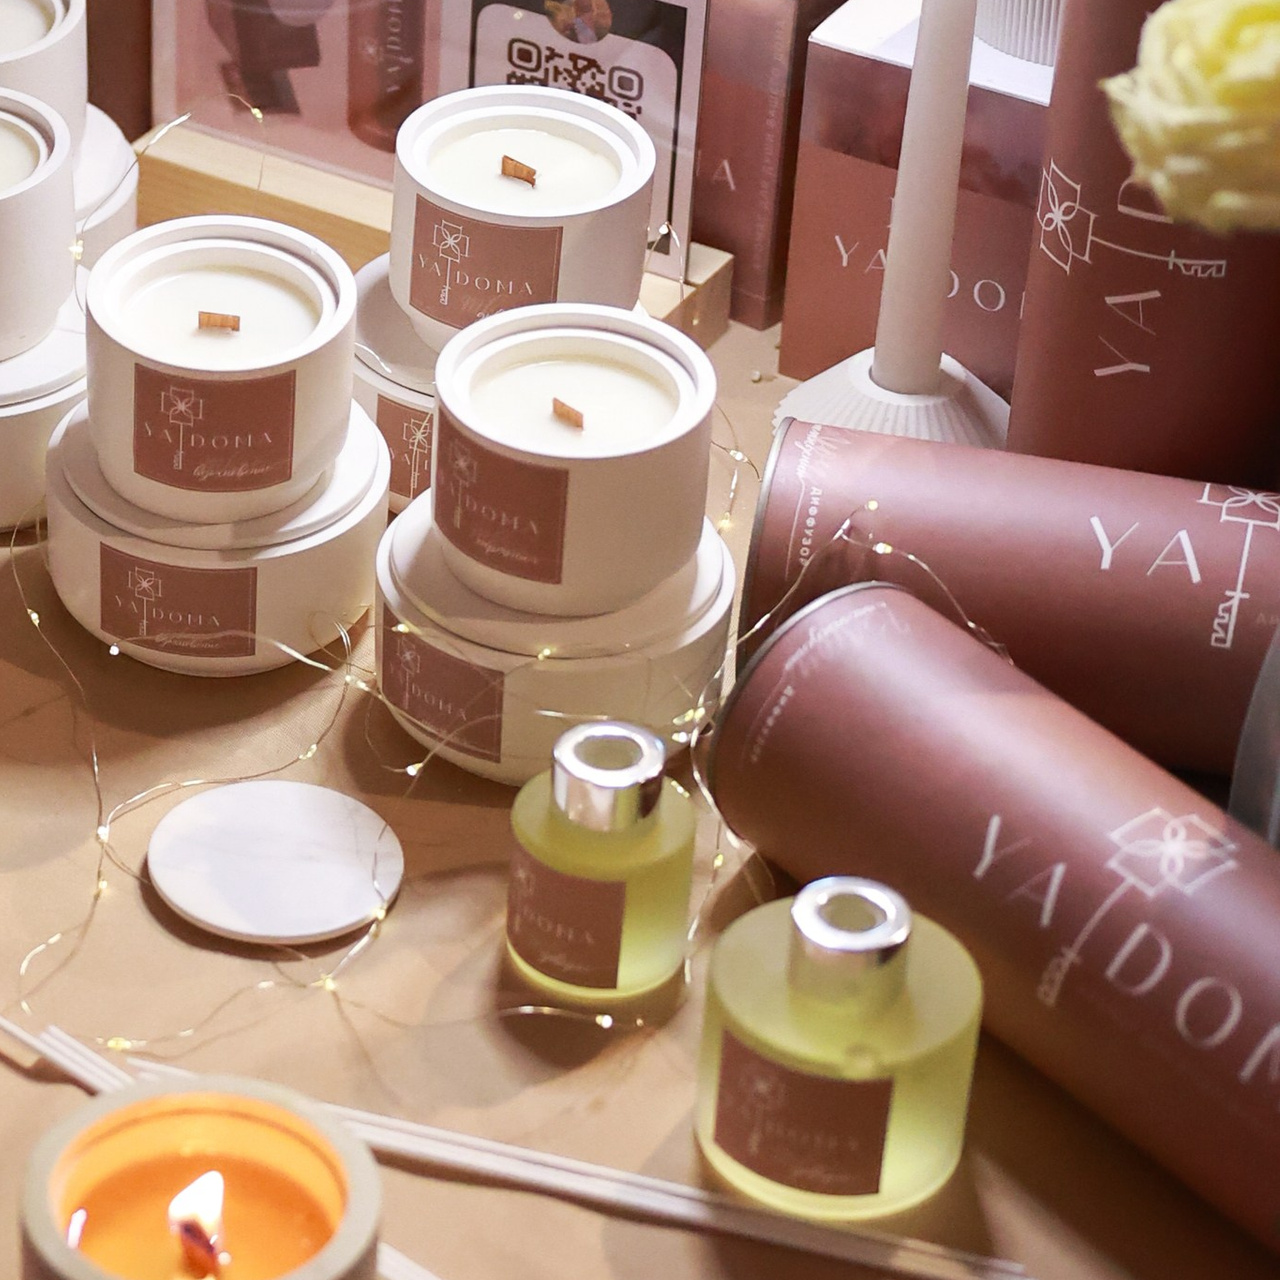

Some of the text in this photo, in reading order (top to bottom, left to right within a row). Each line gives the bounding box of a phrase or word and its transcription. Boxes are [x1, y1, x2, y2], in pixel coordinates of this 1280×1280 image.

[455, 270, 533, 296] DOMA
[1094, 290, 1162, 378] YA
[1089, 515, 1202, 585] YA
[972, 813, 1067, 928] YA
